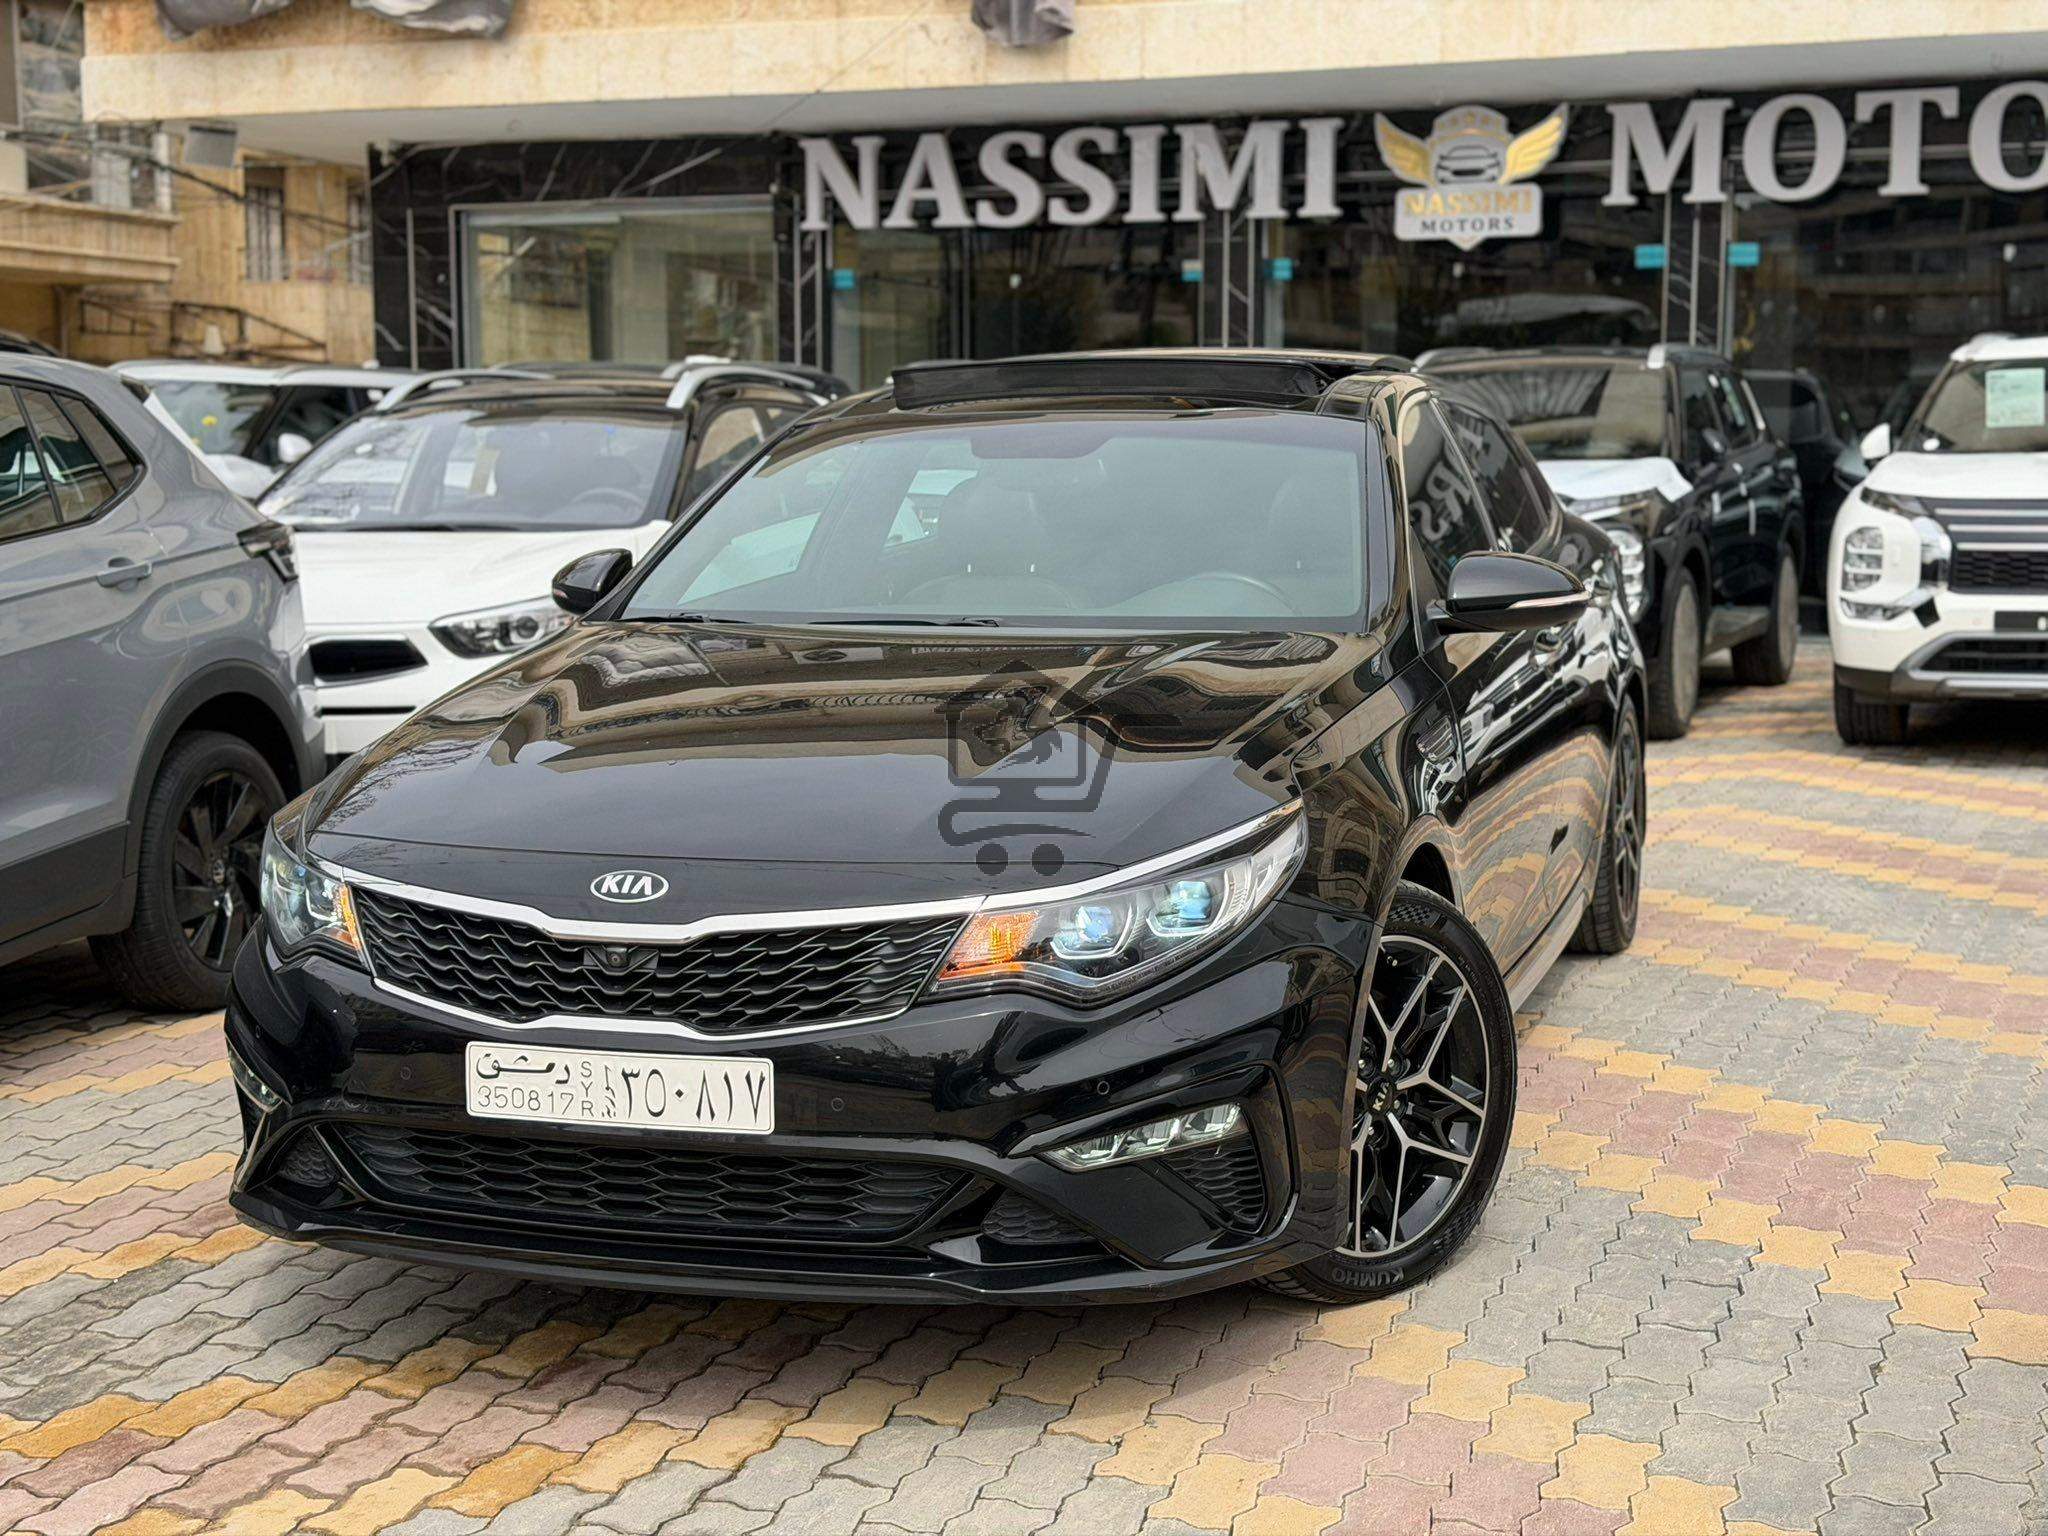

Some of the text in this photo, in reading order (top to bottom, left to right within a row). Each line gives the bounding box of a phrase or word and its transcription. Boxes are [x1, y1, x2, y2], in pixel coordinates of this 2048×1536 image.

[800, 80, 2048, 230] NASSIMI MOTO
[1405, 190, 1532, 216] NASSIMI
[1421, 218, 1515, 232] MOTORS
[600, 874, 653, 896] KIA
[475, 1053, 571, 1085] دمشق
[476, 1085, 574, 1116] 350817
[580, 1060, 594, 1118] SYR
[1331, 1266, 1405, 1288] KUMHO
